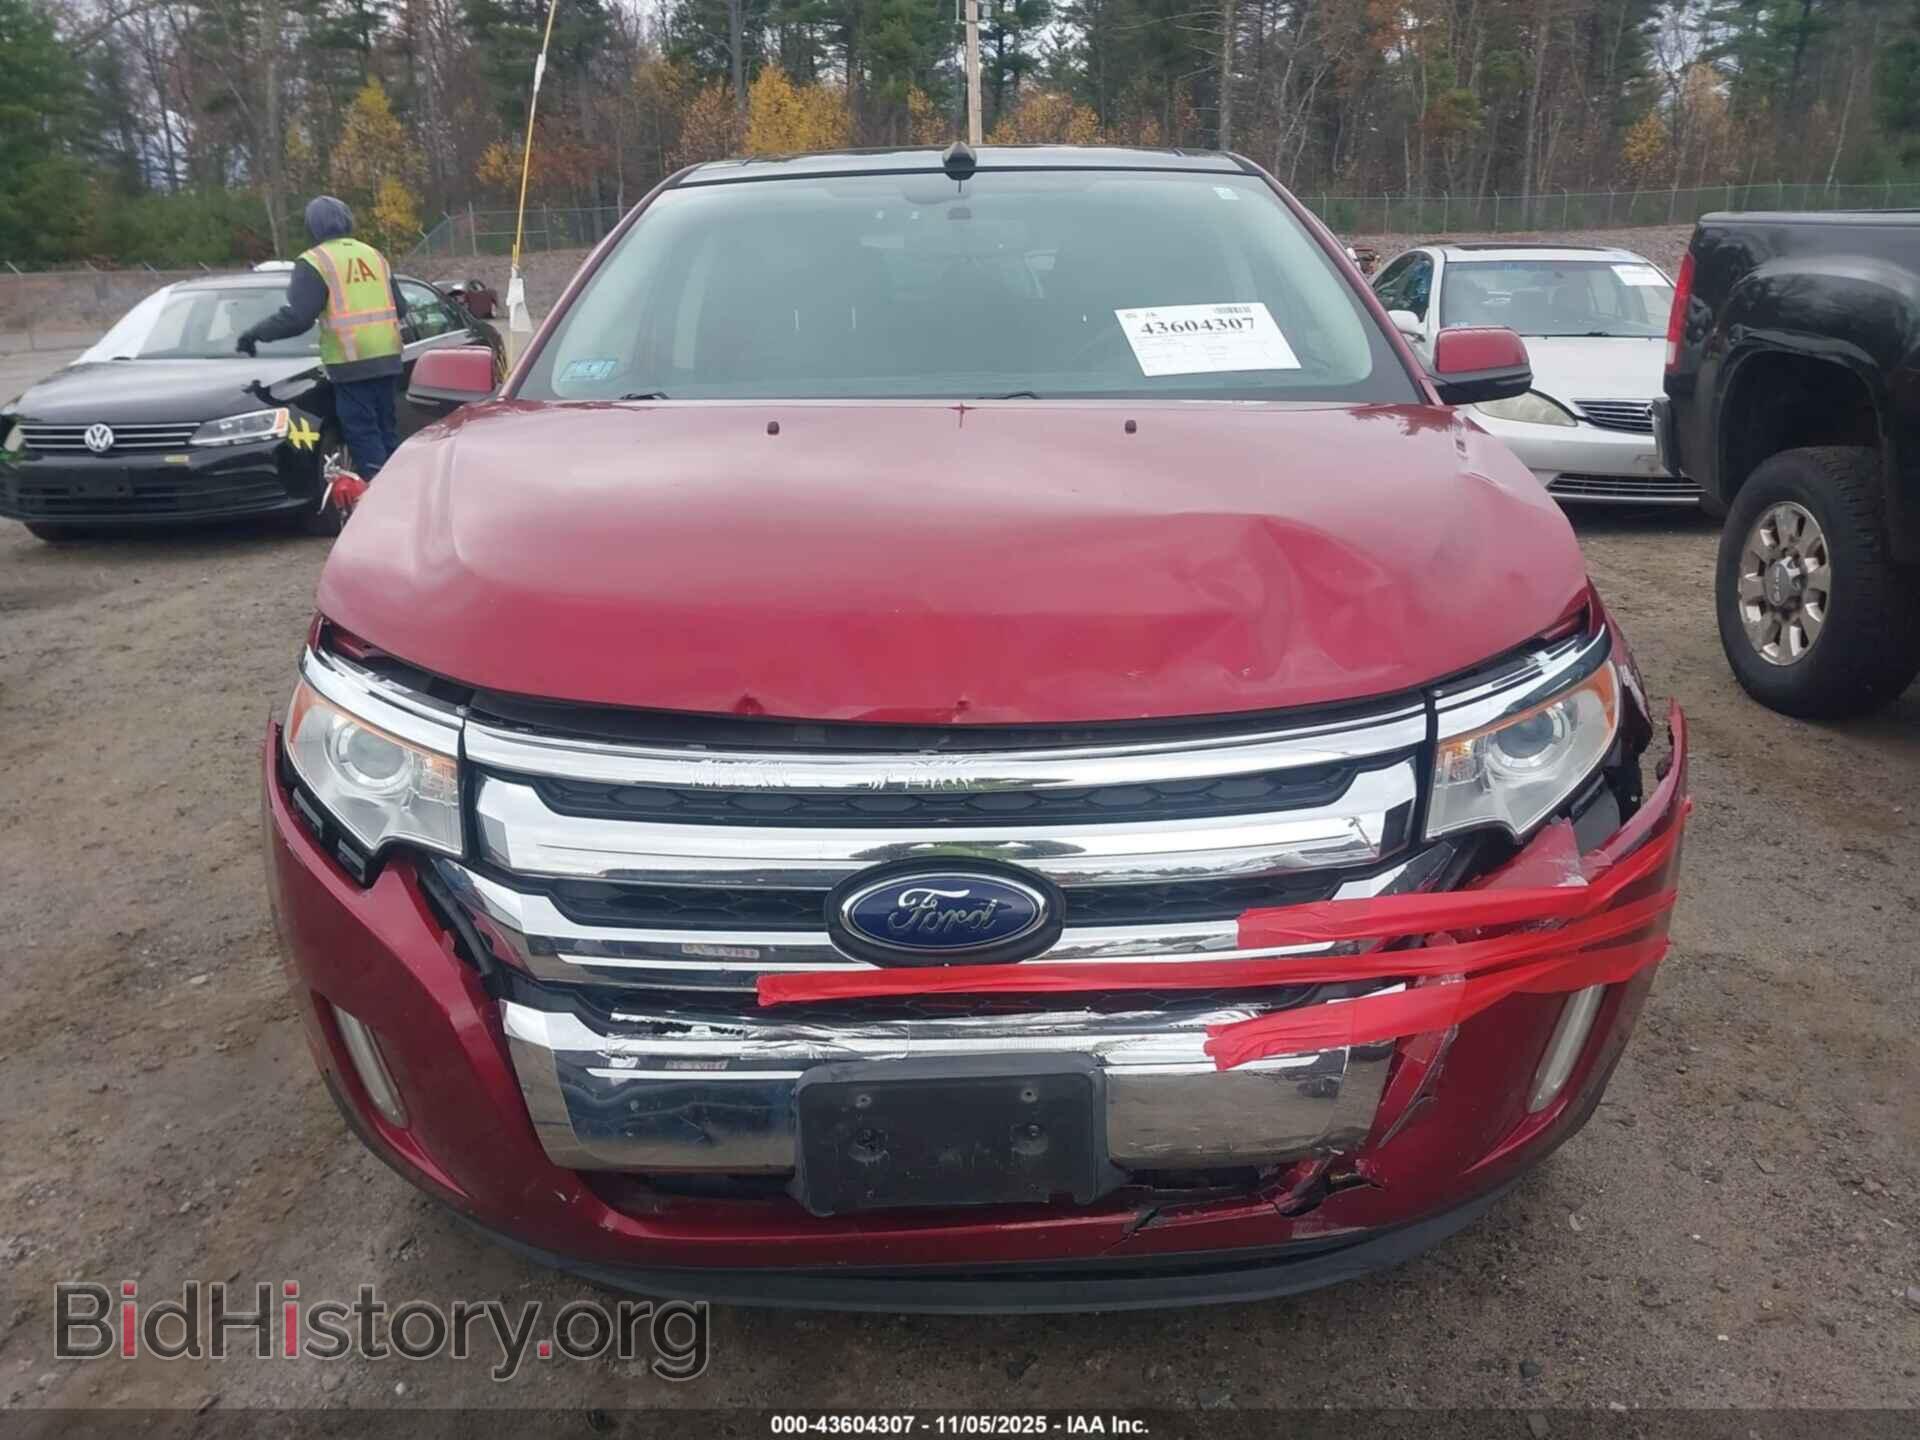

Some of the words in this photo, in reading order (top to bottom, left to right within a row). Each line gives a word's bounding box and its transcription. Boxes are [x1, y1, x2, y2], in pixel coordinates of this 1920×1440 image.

[1140, 317, 1255, 335] 43604307
[85, 423, 114, 452] VW
[887, 887, 998, 932] Ford
